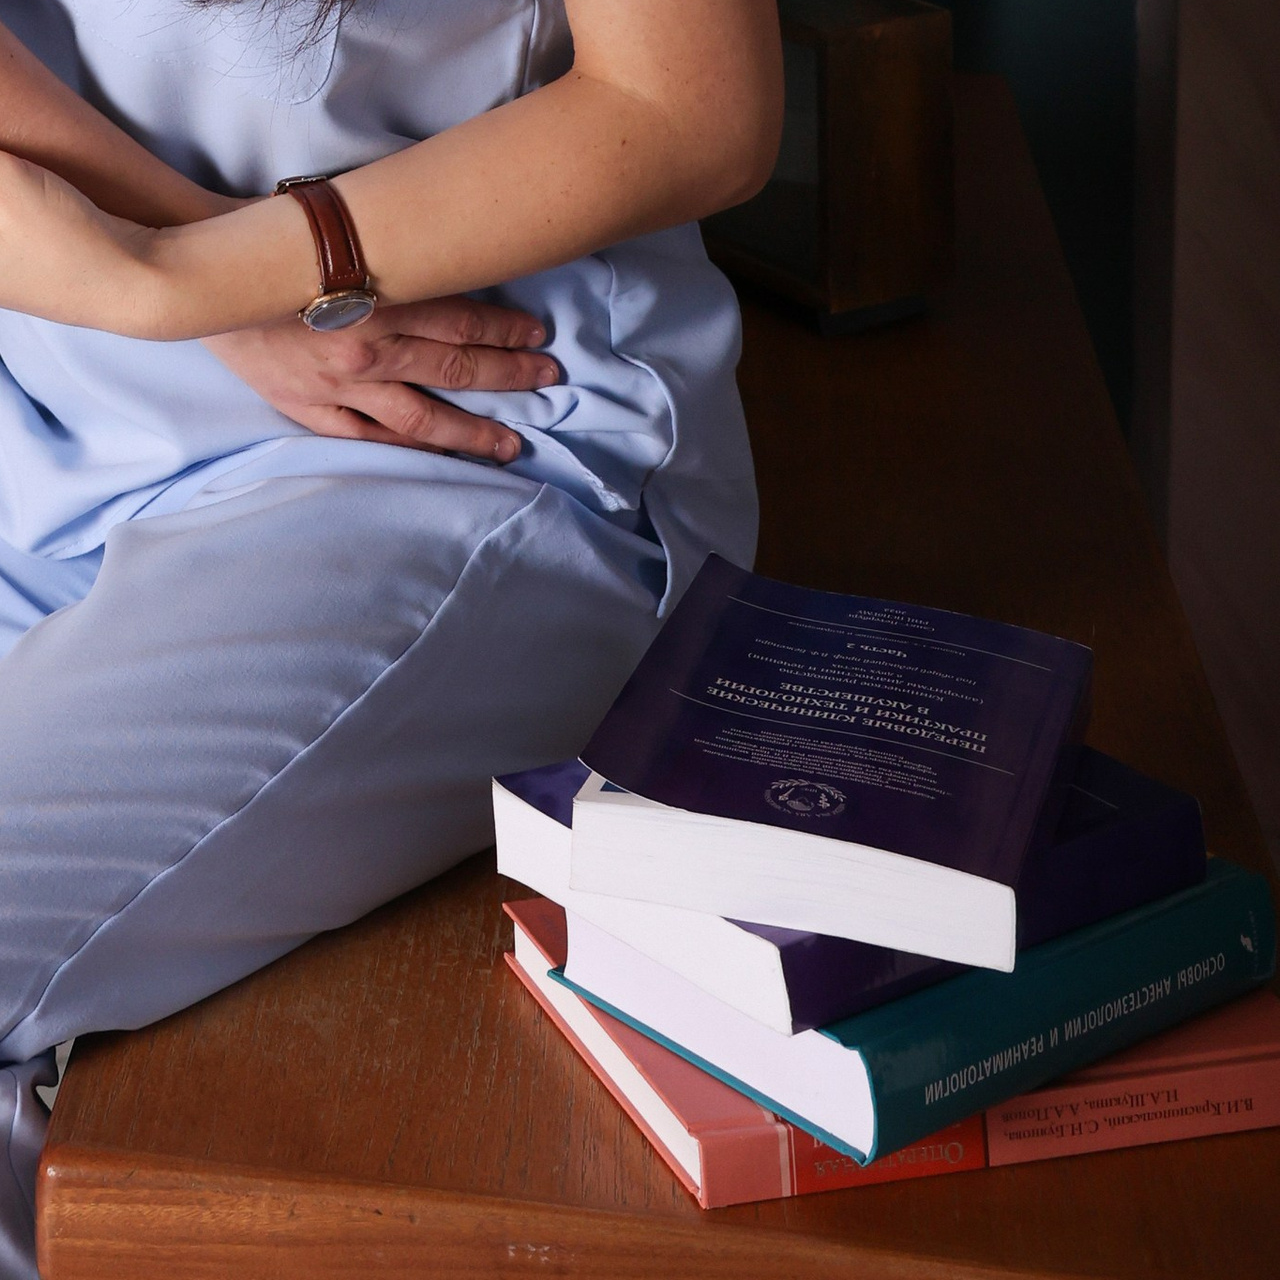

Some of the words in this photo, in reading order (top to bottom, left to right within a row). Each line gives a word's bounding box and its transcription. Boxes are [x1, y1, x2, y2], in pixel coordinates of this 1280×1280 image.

[859, 644, 908, 657] Часть
[778, 665, 857, 685] руководство
[705, 684, 856, 724] КЛИНИЧЕСКИЕ
[714, 676, 849, 712] ТЕХНОЛОГИИ
[778, 680, 912, 711] АКУШЕРСТВЕ
[859, 681, 943, 701] Клиническое
[853, 705, 869, 714] И
[875, 709, 987, 741] ПРАКТИКИ
[915, 705, 929, 714] В
[860, 717, 987, 754] ПЕРЕДОВЫЕ
[1177, 952, 1225, 990] ОСНОВЫ
[1064, 976, 1171, 1041] АНЕСТЕЗИОЛОГИИ
[1049, 1027, 1059, 1048] И
[925, 1034, 1044, 1105] РЕАНИМАТОЛОГИИ
